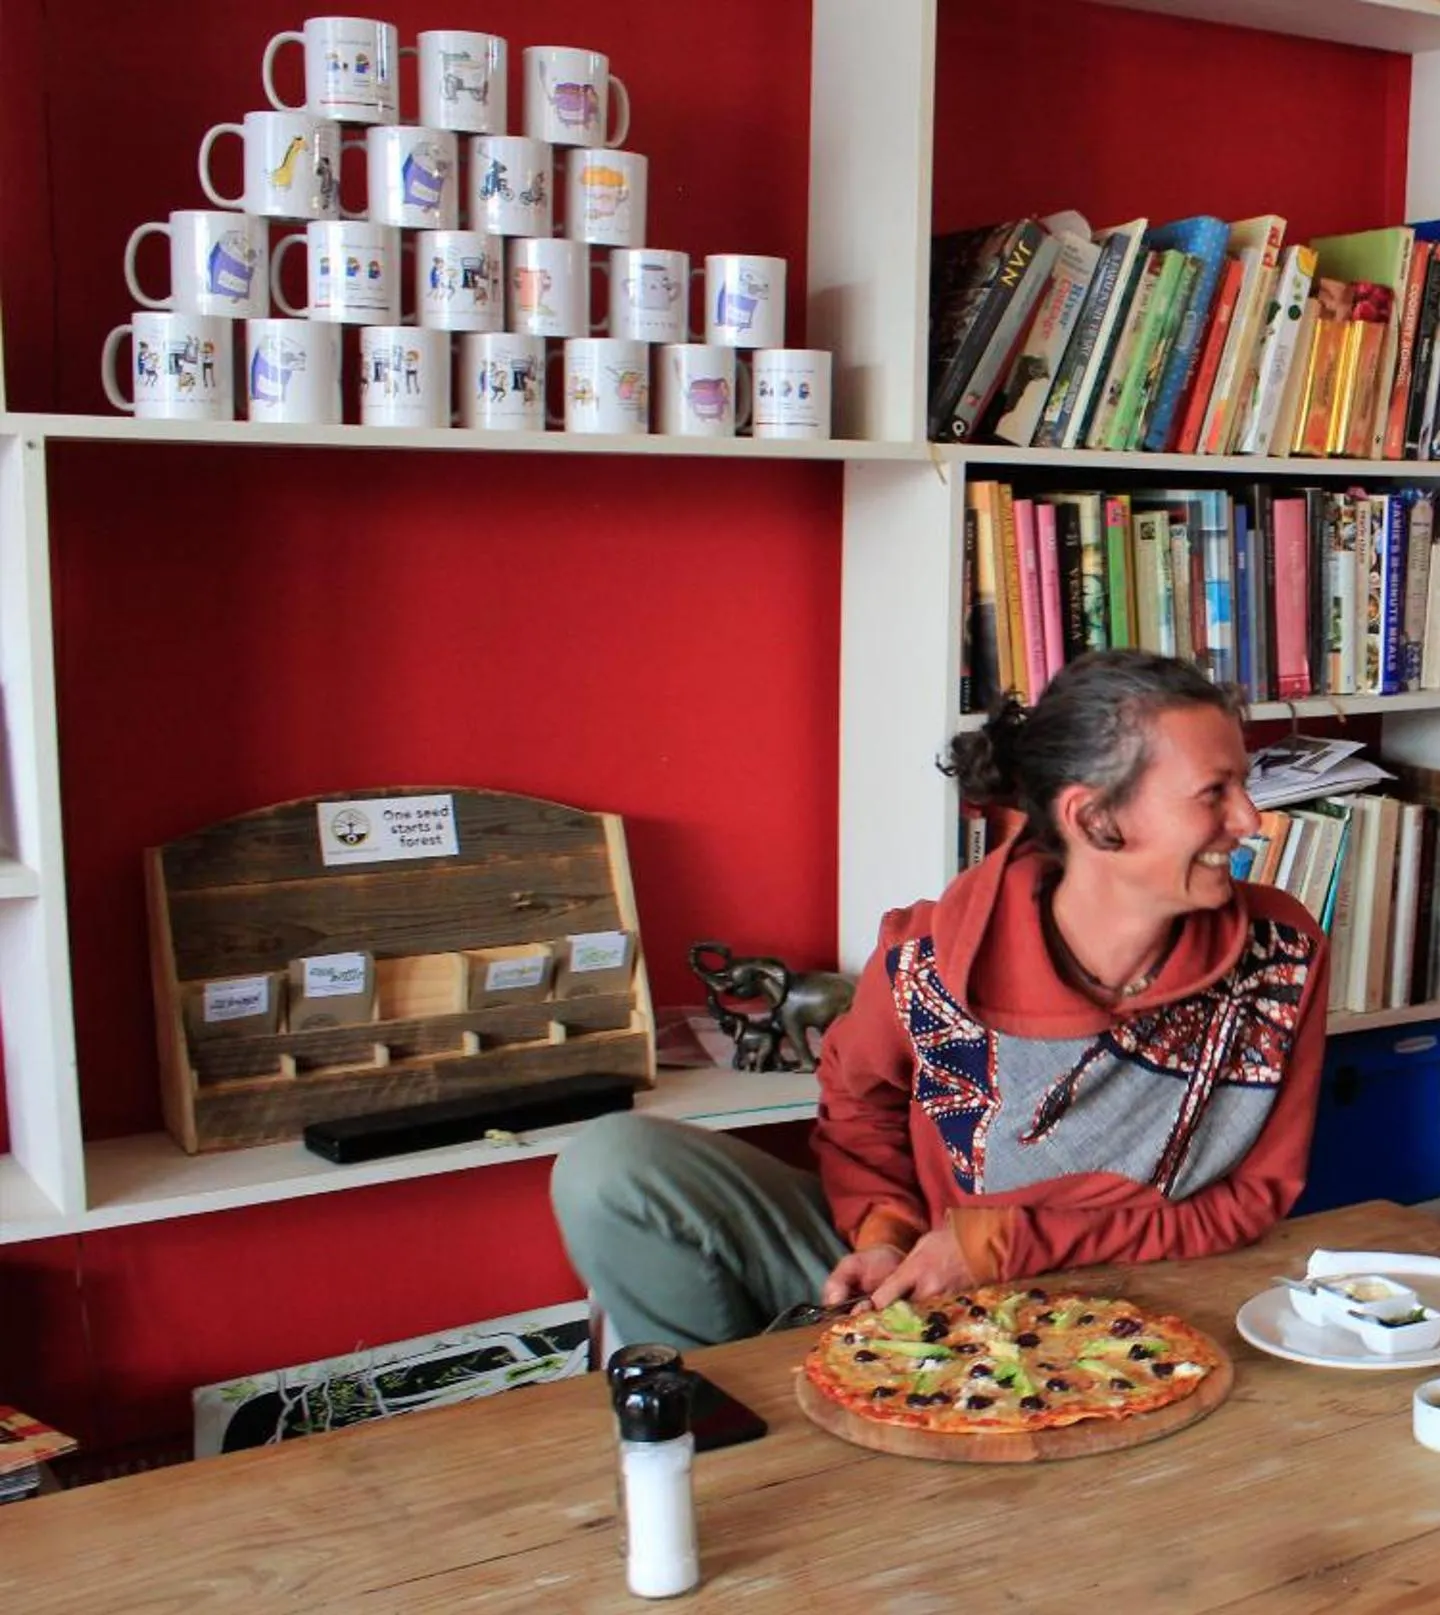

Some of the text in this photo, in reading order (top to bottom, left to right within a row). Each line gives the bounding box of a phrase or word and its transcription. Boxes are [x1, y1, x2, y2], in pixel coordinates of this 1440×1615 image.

[1000, 239, 1032, 288] JAN
[383, 804, 449, 820] One seed
[391, 823, 431, 834] starts
[400, 836, 443, 848] forest
